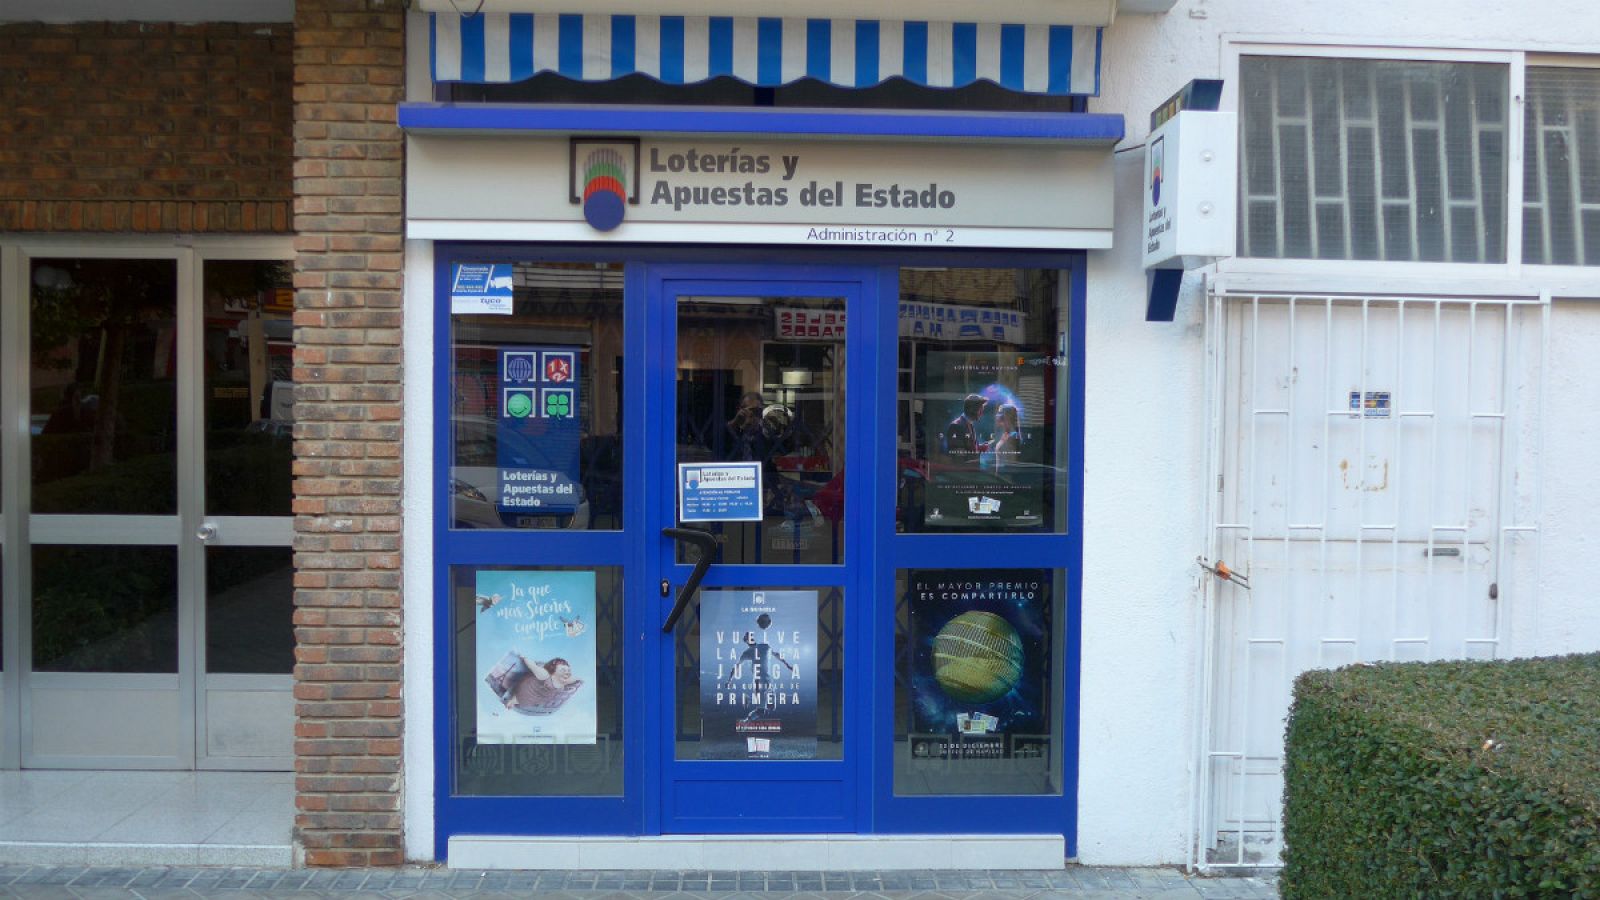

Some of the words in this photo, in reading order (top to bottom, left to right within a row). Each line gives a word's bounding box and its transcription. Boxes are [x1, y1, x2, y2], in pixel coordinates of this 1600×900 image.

[650, 147, 770, 174] Loterías
[782, 155, 799, 181] y
[650, 180, 788, 211] Apuestas
[799, 181, 843, 207] del
[855, 183, 956, 209] Estado
[806, 226, 917, 242] Administración
[946, 229, 955, 242] 2
[503, 471, 547, 481] Loterías
[551, 473, 557, 483] y
[503, 484, 554, 496] Apuestas
[556, 484, 573, 494] del
[503, 496, 541, 507] Estado
[938, 582, 981, 590] MAYOR
[989, 582, 1038, 590] PREMIO
[942, 592, 1034, 600] COMPARTIRLO
[716, 631, 800, 645] VUELVE
[716, 647, 737, 661] LA
[754, 647, 800, 661] LIGA
[716, 664, 800, 679] JUEGA
[716, 693, 800, 705] PRIMERA
